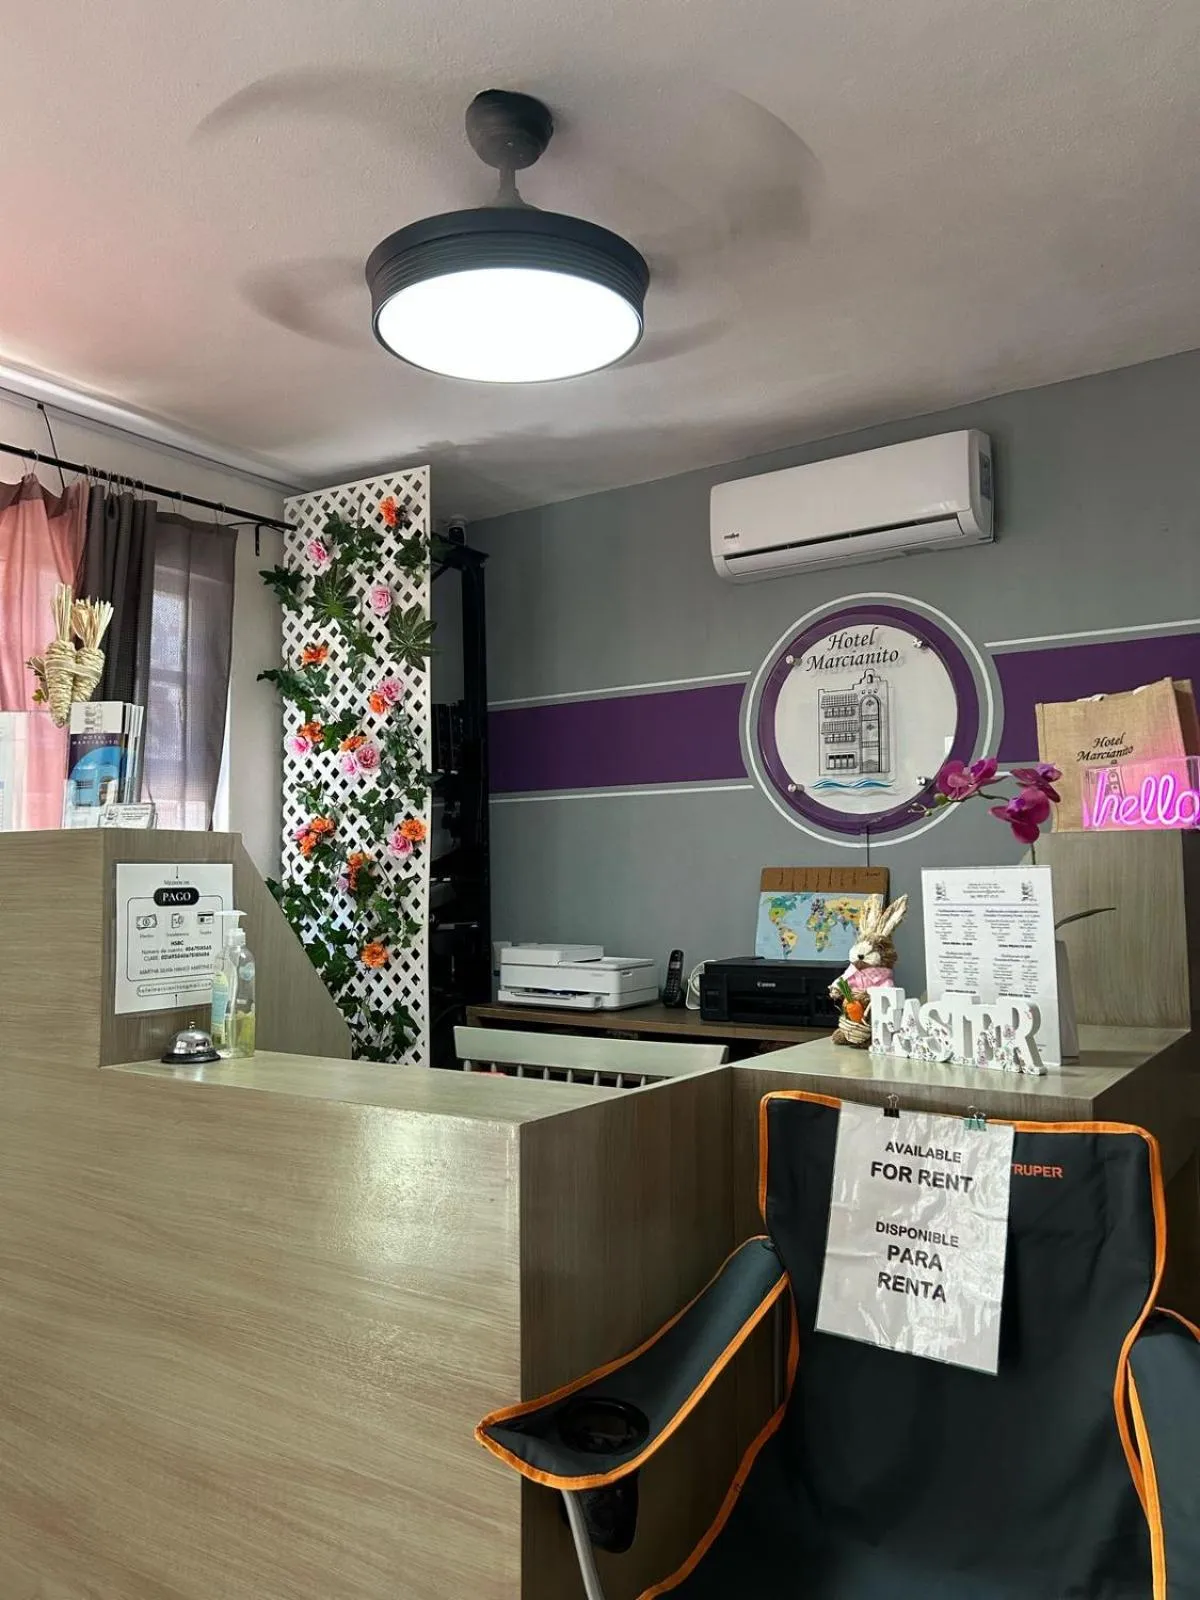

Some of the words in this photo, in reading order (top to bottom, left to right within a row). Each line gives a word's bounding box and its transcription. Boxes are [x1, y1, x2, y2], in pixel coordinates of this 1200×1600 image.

[827, 626, 879, 651] Hotel
[805, 646, 899, 672] Marcianito
[1092, 731, 1127, 749] Hotel
[1090, 773, 1200, 827] hello
[162, 891, 191, 902] PAGO
[885, 1141, 962, 1164] AVAILABLE
[871, 1161, 912, 1184] FOR
[917, 1169, 973, 1194] RENT
[875, 1221, 960, 1248] DISPONIBLE
[887, 1244, 943, 1272] PARA
[878, 1271, 947, 1303] RENTA
